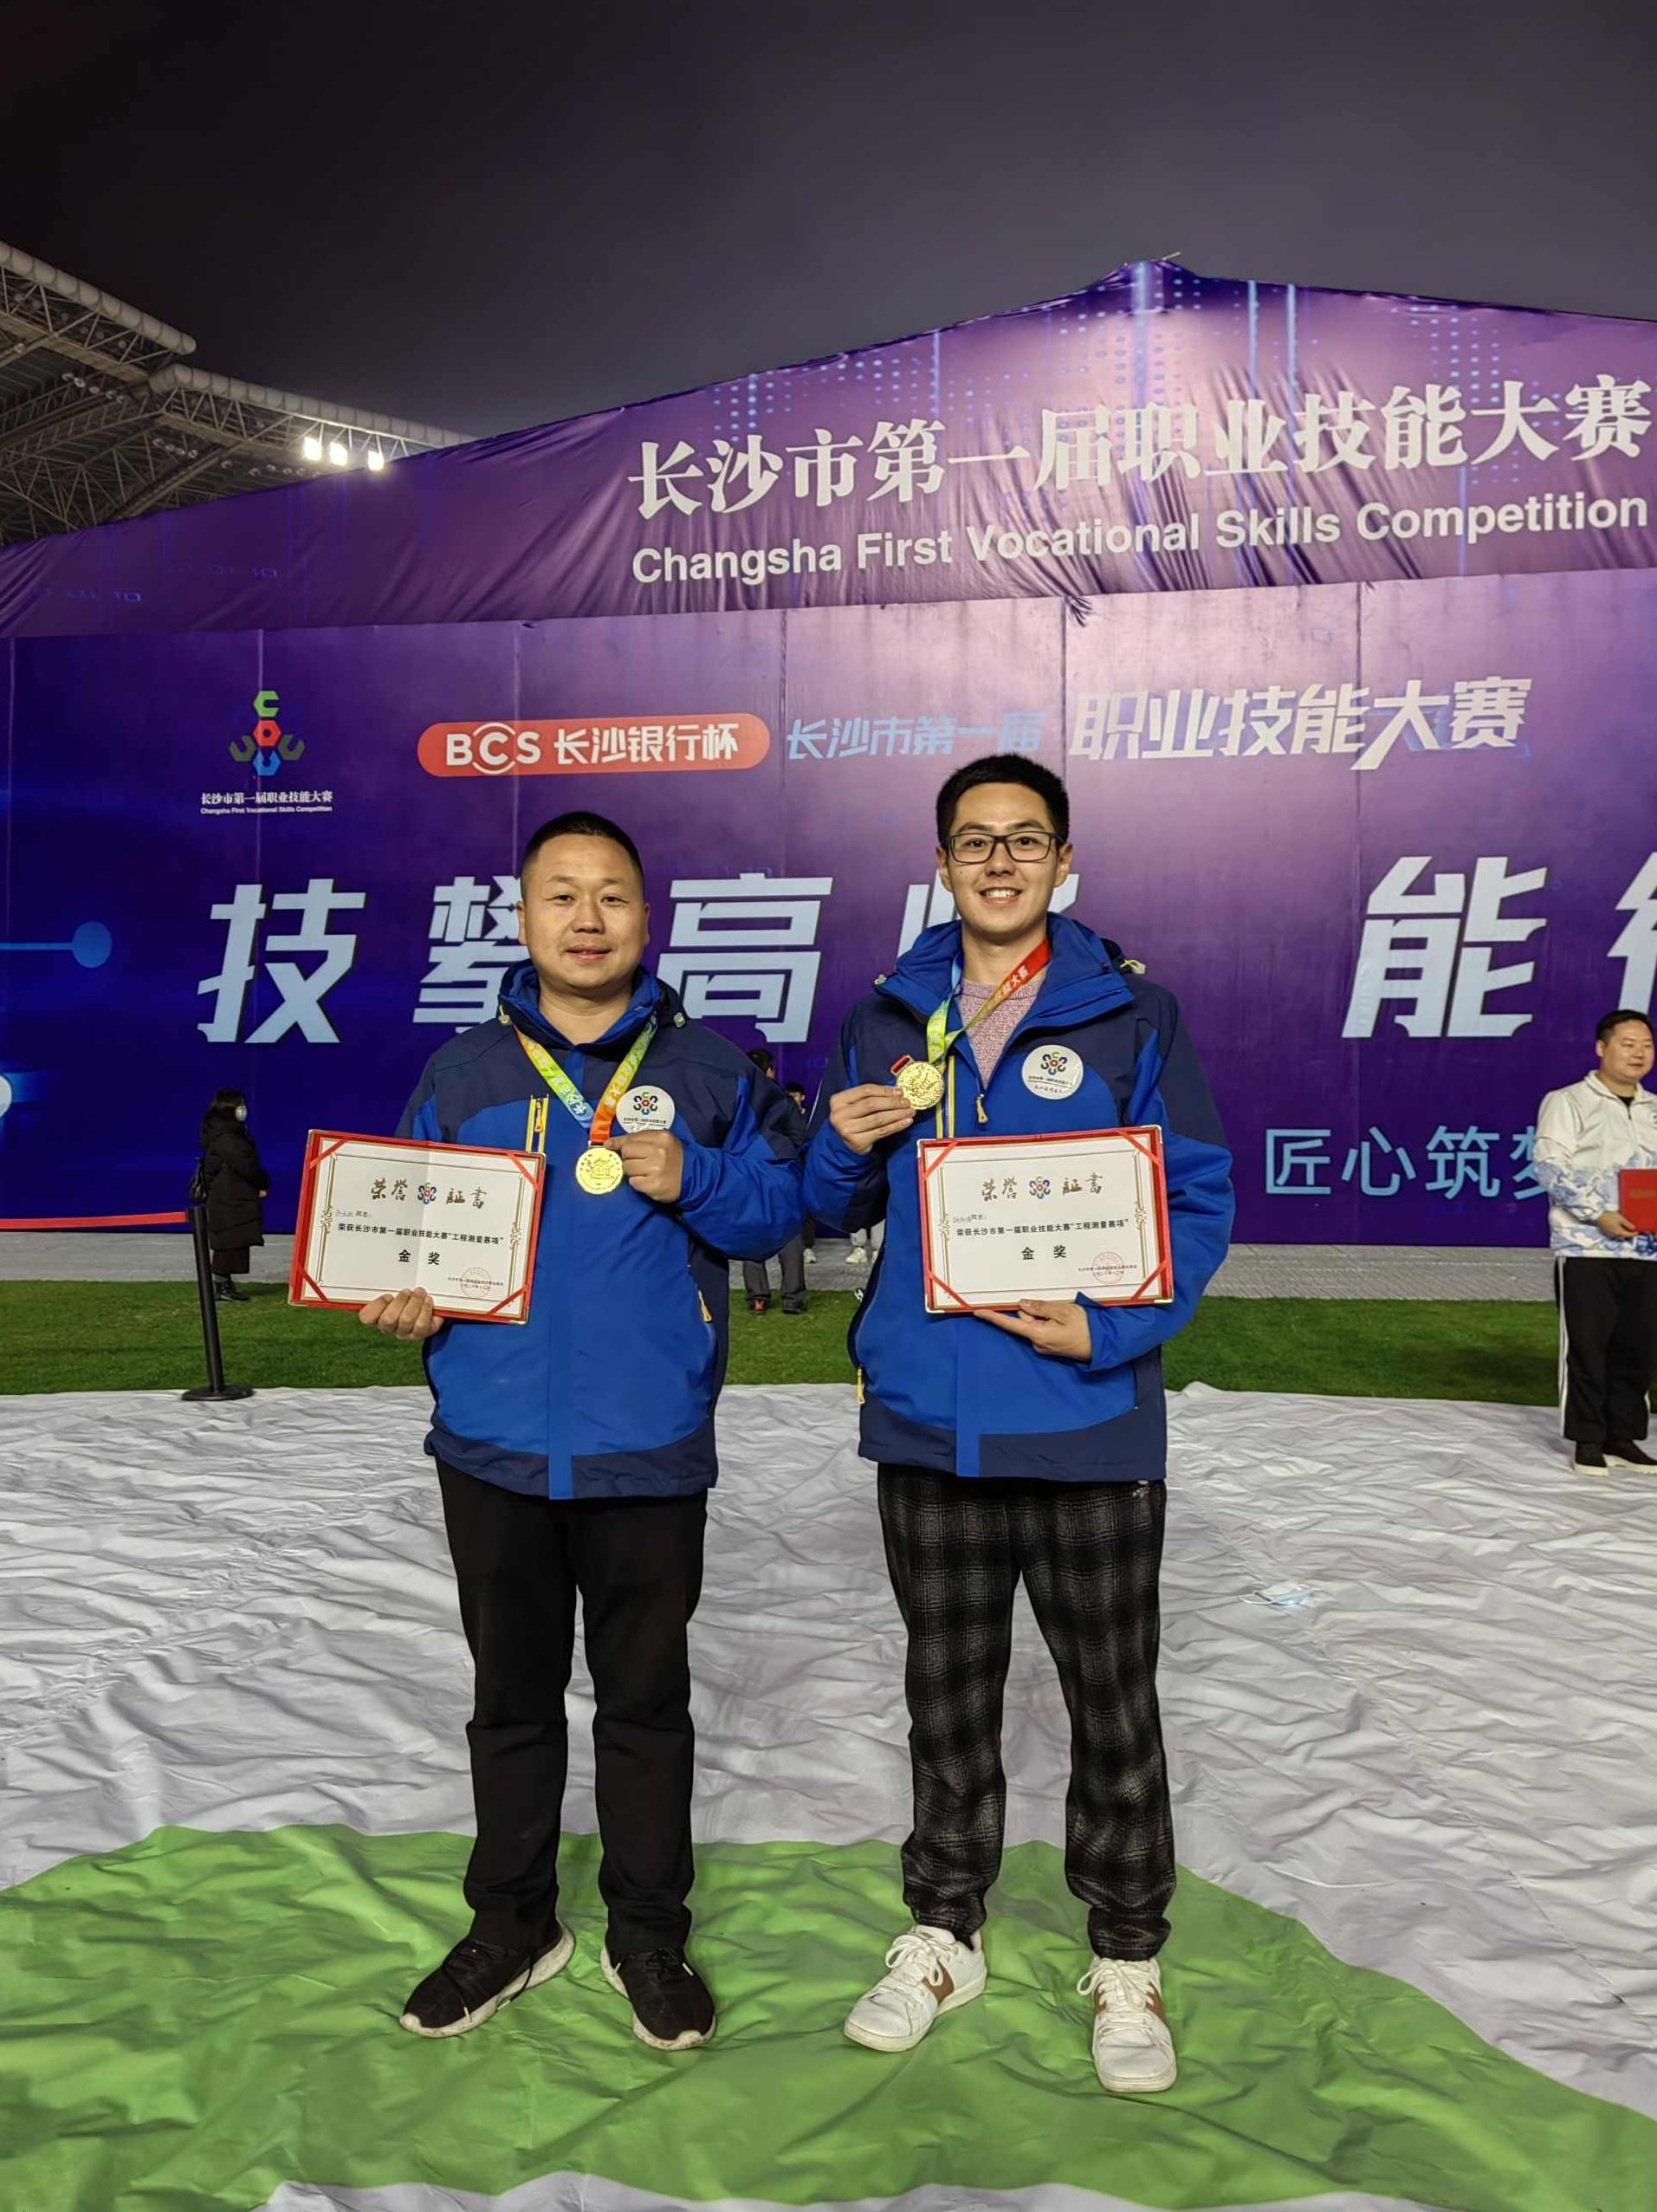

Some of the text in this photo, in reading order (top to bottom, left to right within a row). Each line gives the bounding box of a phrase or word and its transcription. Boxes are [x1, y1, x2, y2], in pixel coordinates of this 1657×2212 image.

[628, 373, 1653, 520] 长沙市第一届职业技能大赛
[632, 490, 1649, 585] Changsha First Vocational Skills Competition
[445, 723, 740, 767] BCS 长沙银行杯
[786, 676, 1533, 771] 长沙市第一届 职业技能大赛
[201, 789, 333, 805] 长沙市第一届职业技能大赛
